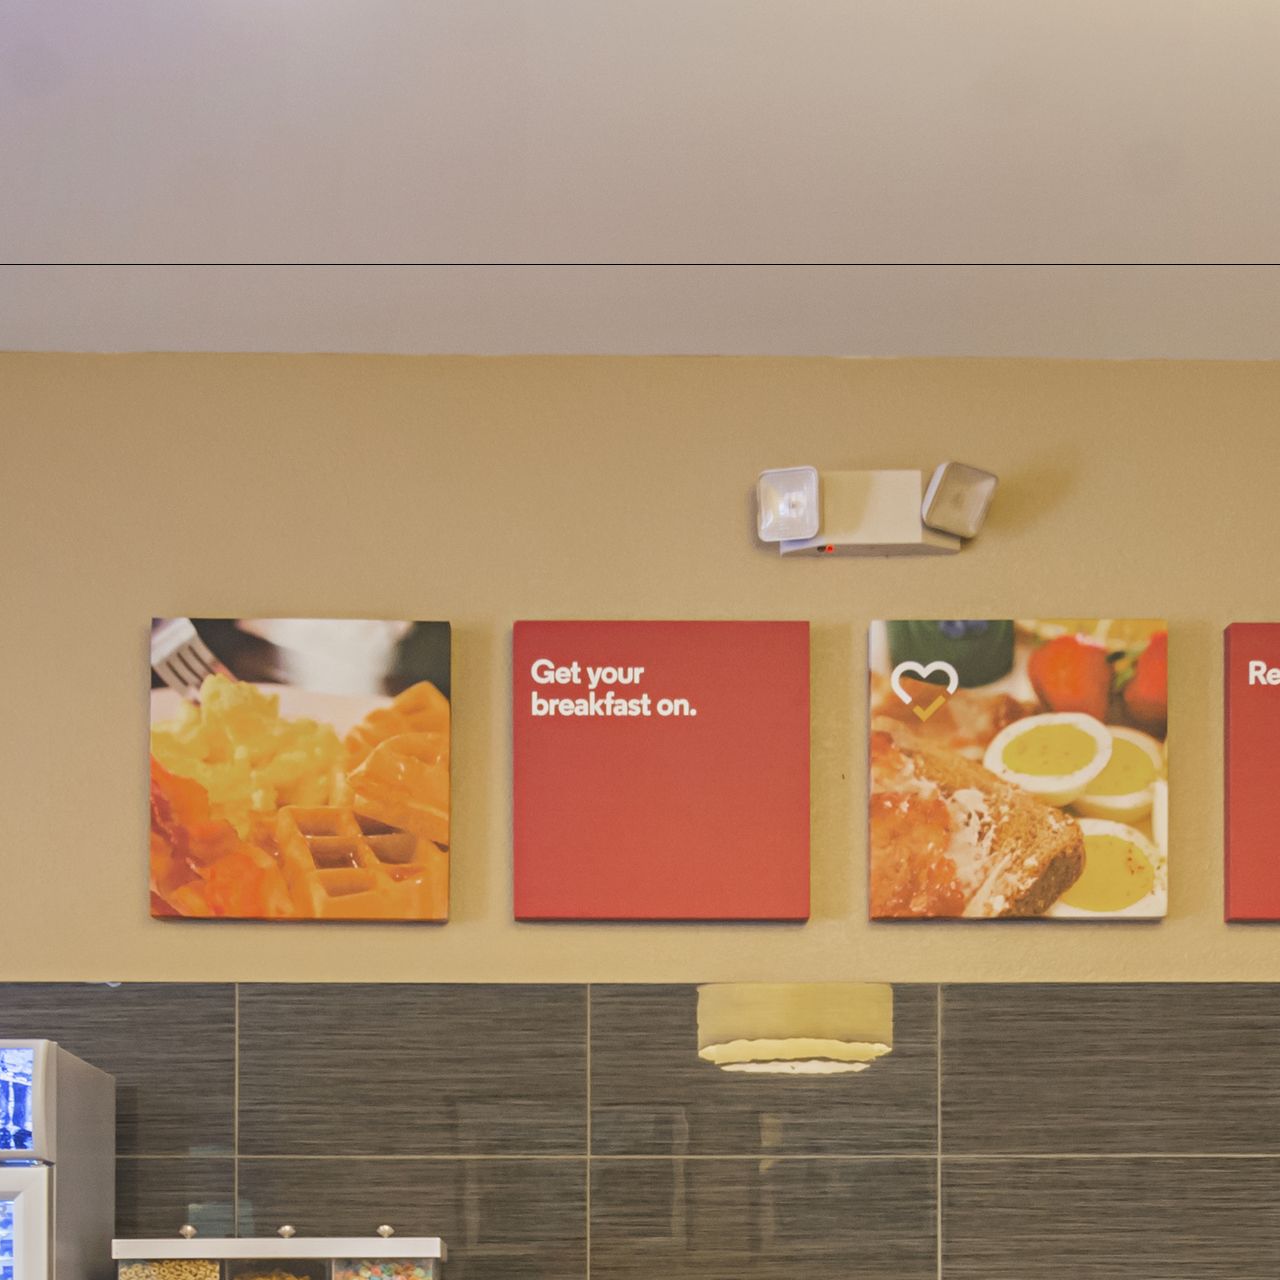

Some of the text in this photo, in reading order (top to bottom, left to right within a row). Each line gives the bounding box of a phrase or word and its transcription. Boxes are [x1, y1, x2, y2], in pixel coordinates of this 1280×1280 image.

[531, 658, 644, 689] Get your
[531, 691, 697, 716] breakfast on.
